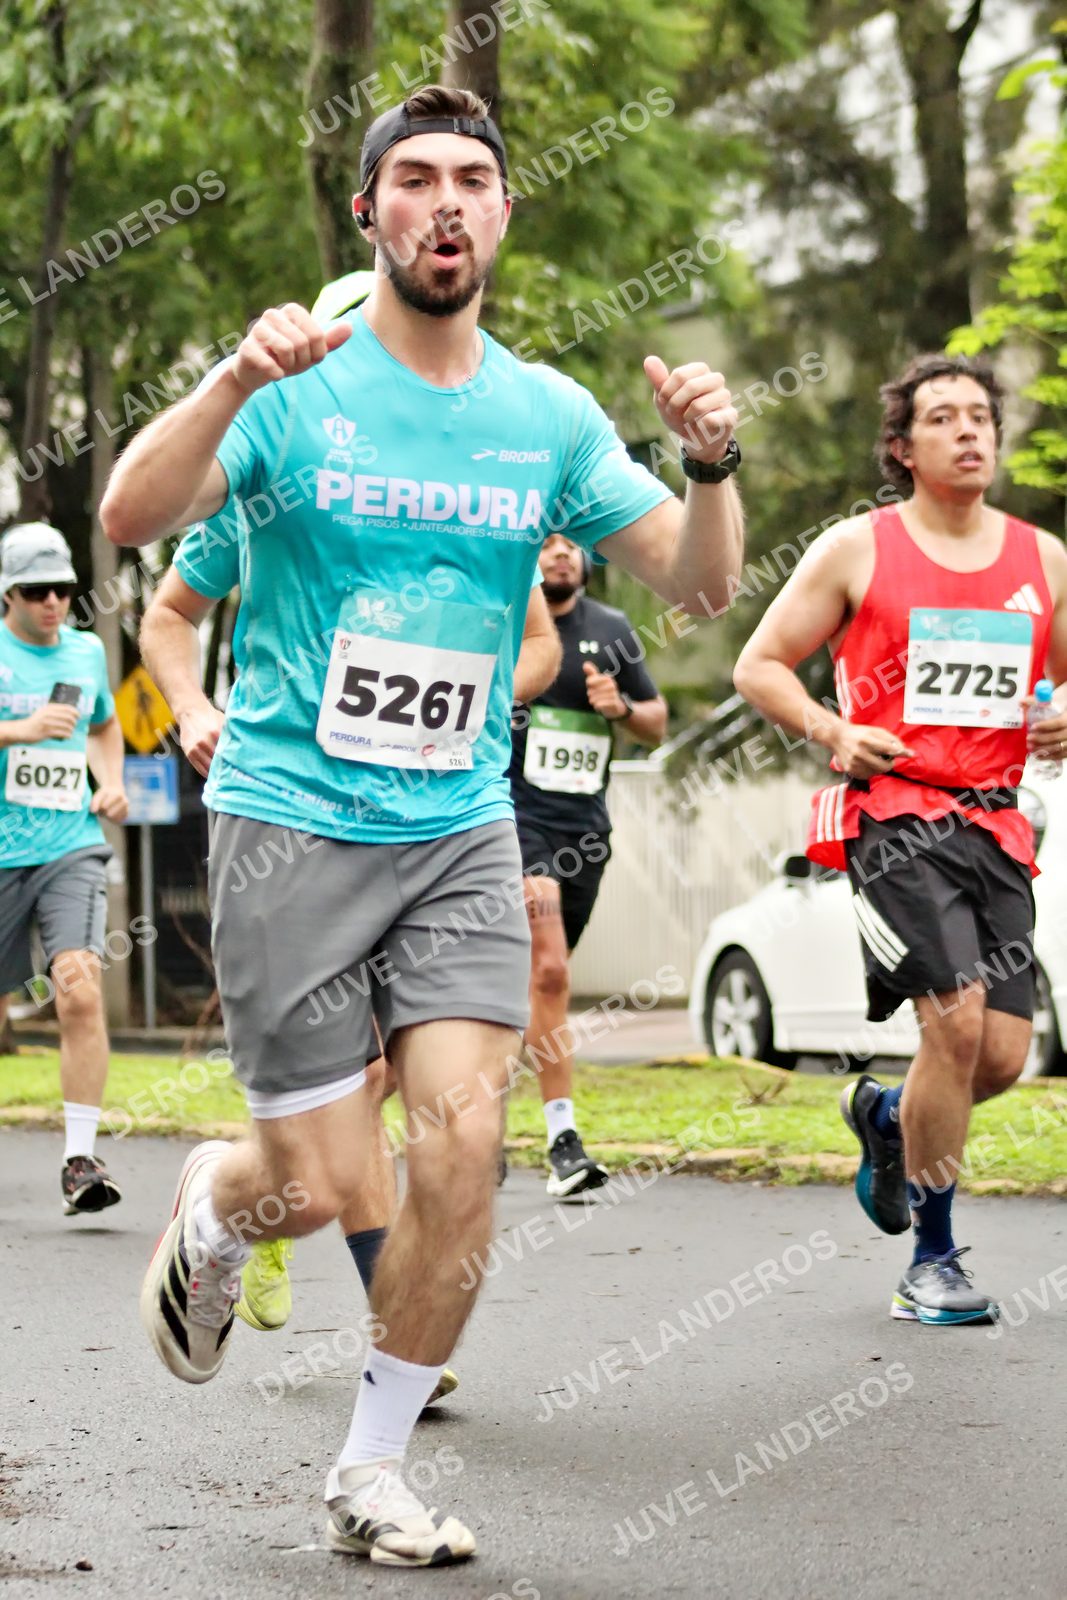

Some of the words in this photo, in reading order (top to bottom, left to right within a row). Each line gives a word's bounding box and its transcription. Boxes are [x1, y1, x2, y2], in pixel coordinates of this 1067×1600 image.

[498, 449, 551, 463] BROOKS
[315, 469, 542, 530] PERDURA
[332, 514, 363, 526] PEGA
[366, 517, 400, 529] PISOS
[408, 521, 486, 538] JUNTEADORES
[916, 662, 1018, 699] 2725
[335, 665, 476, 732] 5261
[329, 731, 372, 747] PERDURA
[536, 745, 599, 772] 1998
[15, 764, 81, 790] 6027
